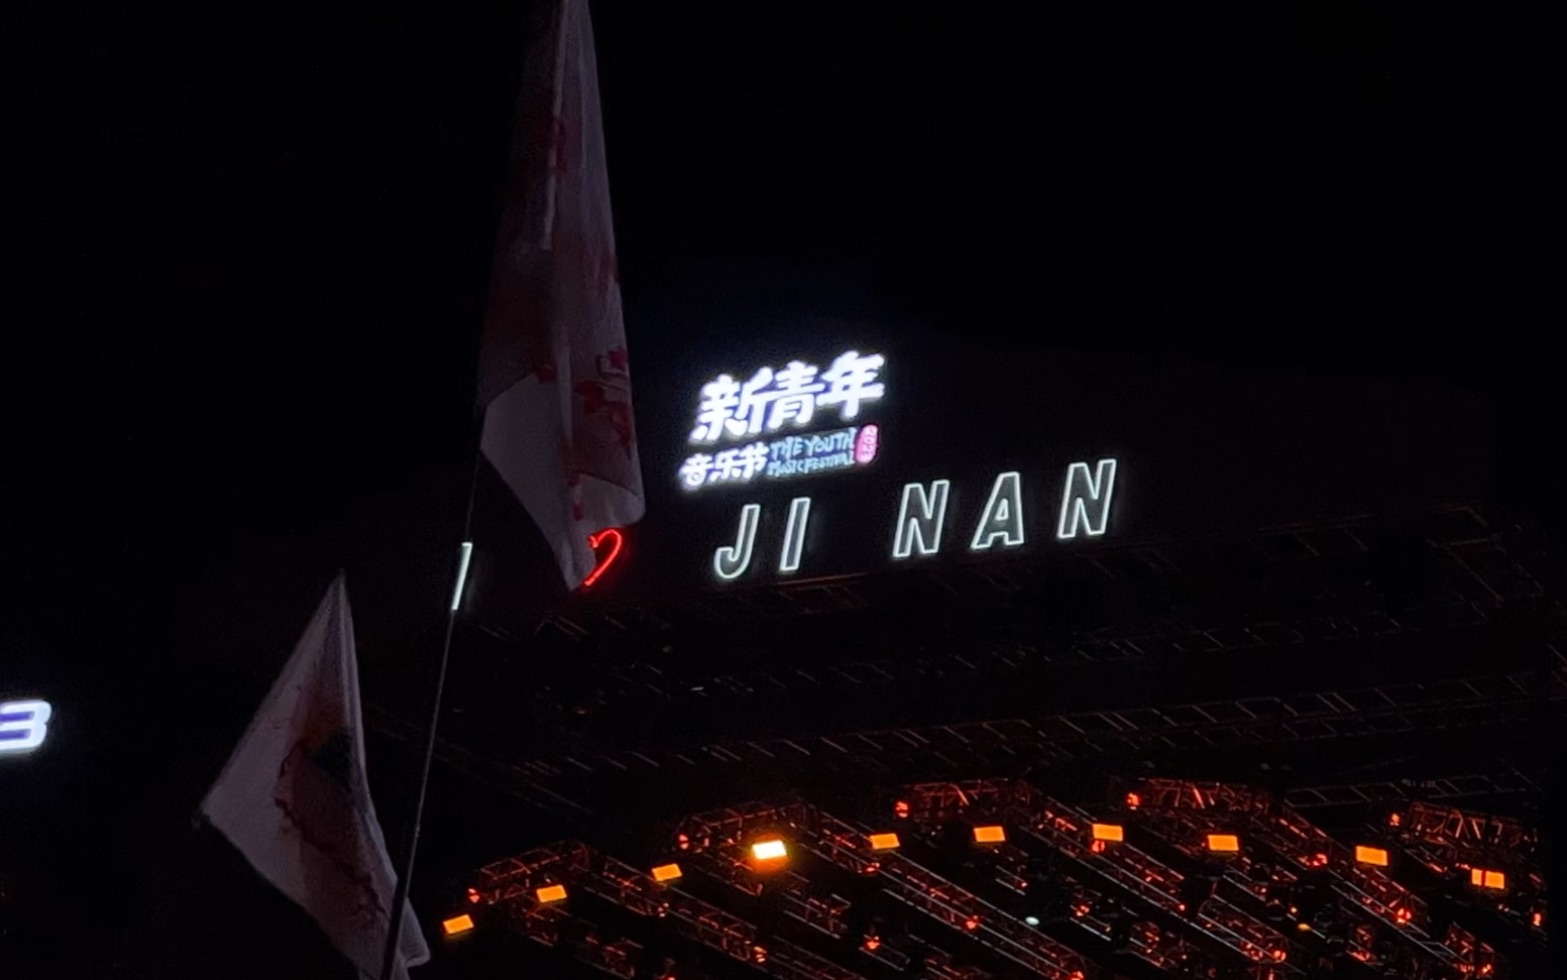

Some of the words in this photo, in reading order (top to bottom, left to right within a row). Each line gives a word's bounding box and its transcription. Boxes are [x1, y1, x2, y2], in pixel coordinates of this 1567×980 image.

[689, 350, 885, 441] 新青年
[679, 441, 769, 490] 音乐节
[770, 436, 804, 461] THE
[804, 427, 858, 457] YOUTH
[713, 495, 811, 580] JI
[892, 459, 1118, 559] NAN
